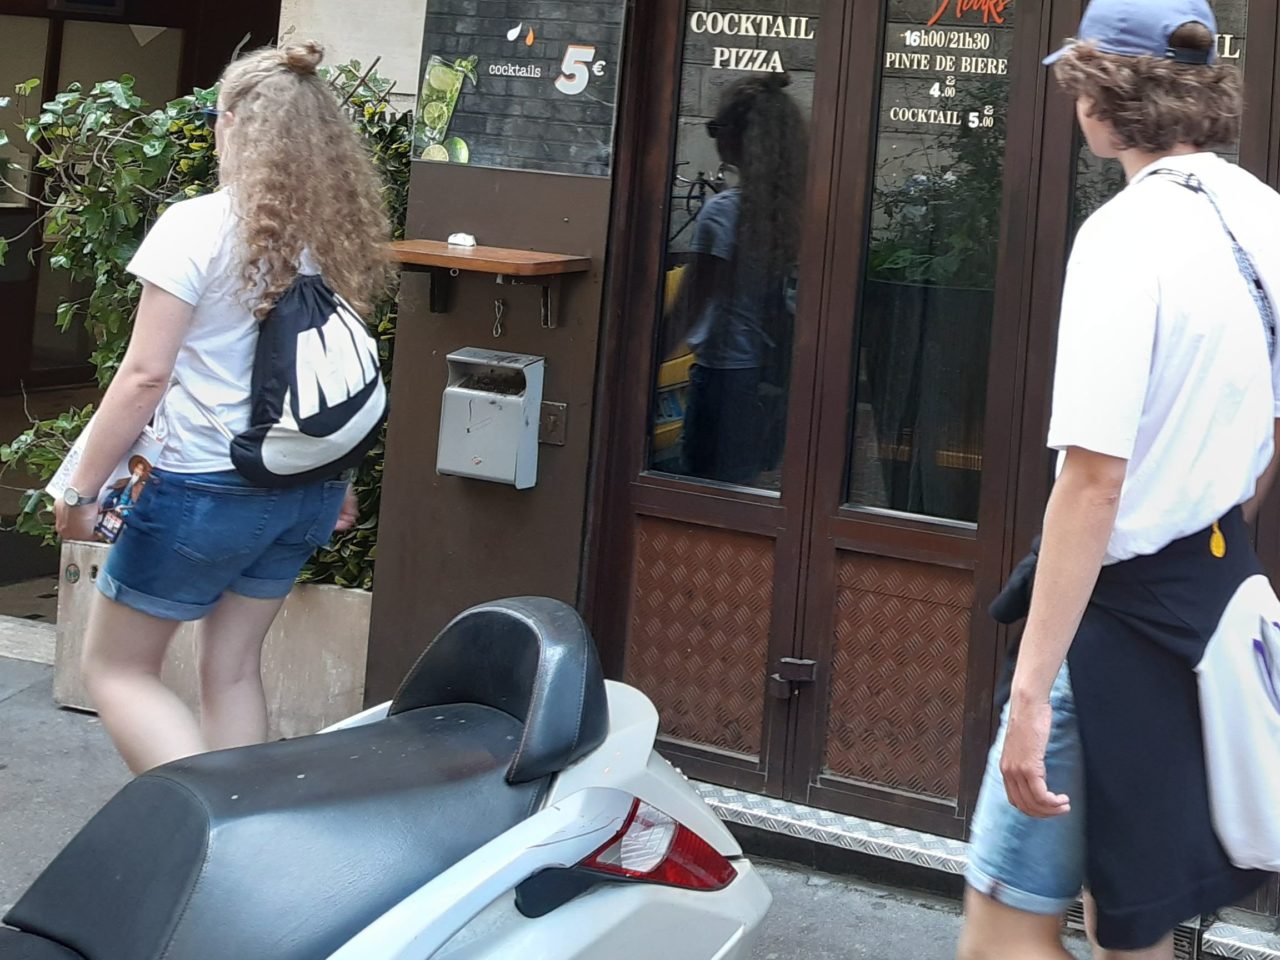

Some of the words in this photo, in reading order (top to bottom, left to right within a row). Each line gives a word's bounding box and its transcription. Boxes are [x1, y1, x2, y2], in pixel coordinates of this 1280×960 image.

[690, 11, 815, 40] COCKTAIL
[903, 29, 990, 50] 16h00/21h30
[489, 62, 541, 78] cocktails
[712, 46, 785, 73] PIZZA
[885, 52, 931, 70] PINTE
[935, 54, 956, 72] DE
[960, 56, 1008, 75] BIERE
[890, 107, 962, 125] COCKTAIL
